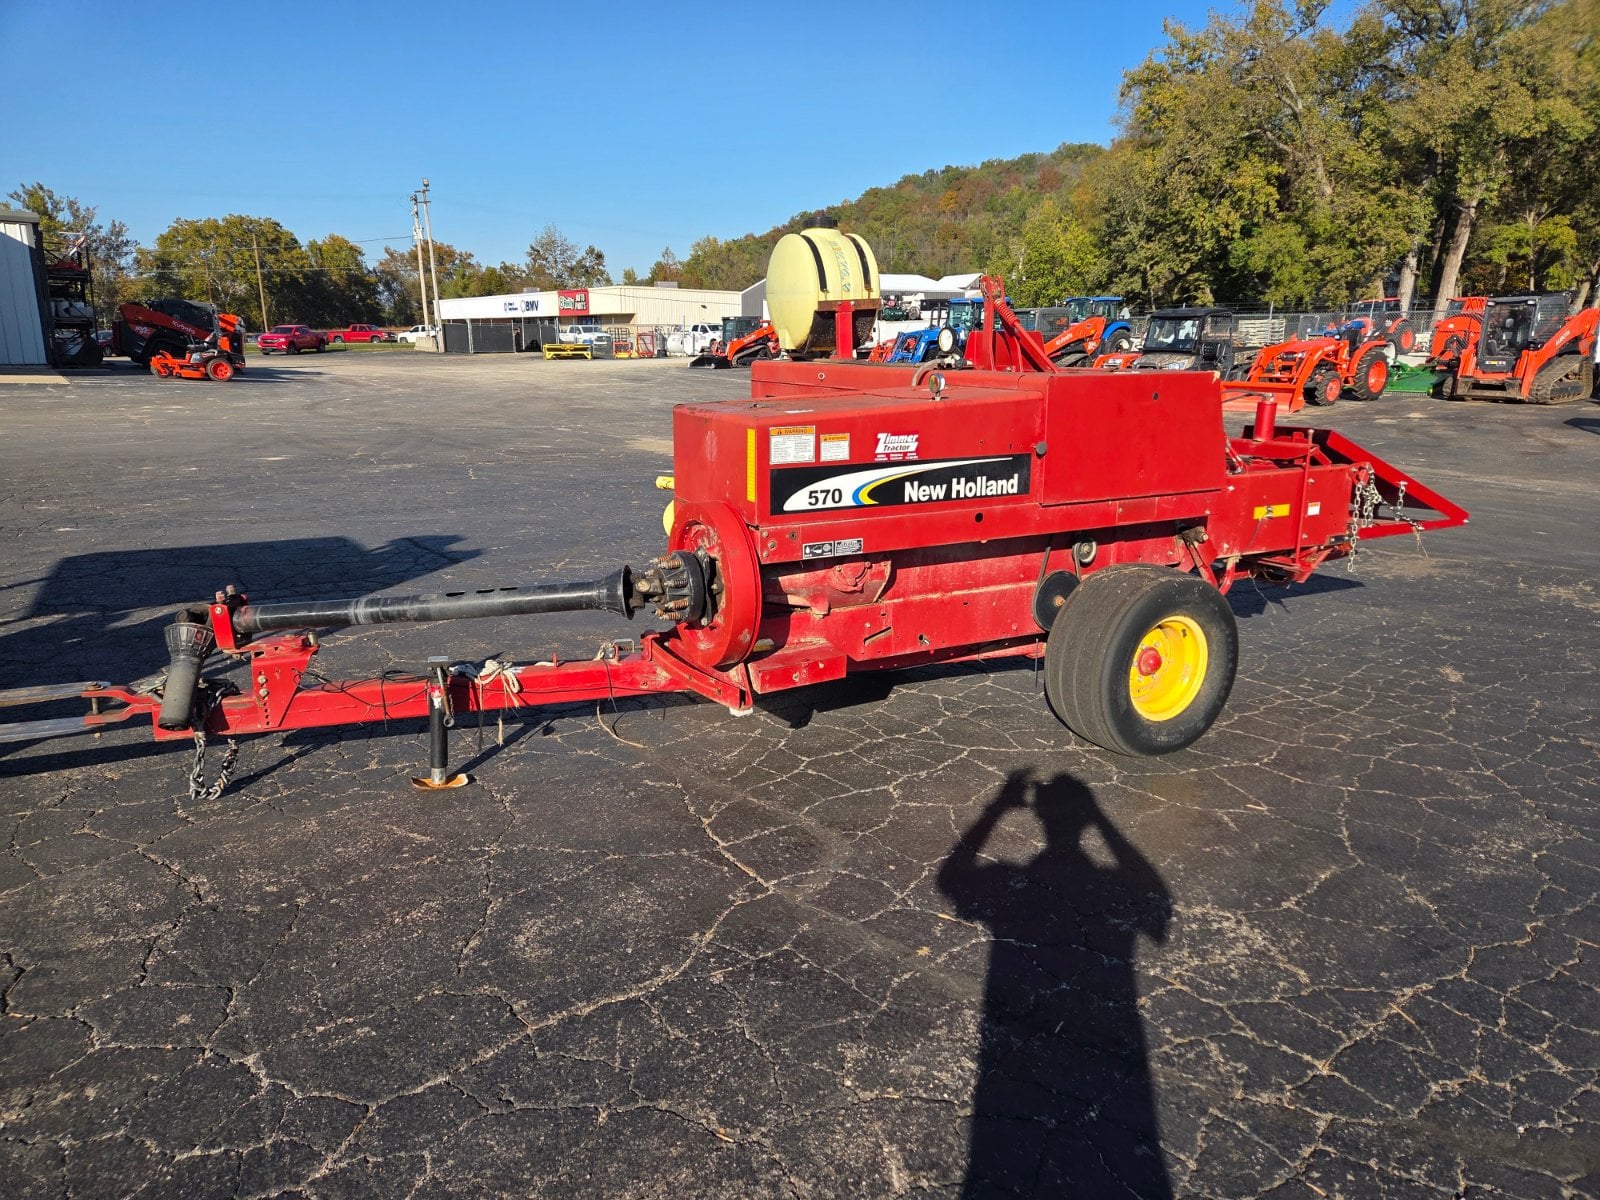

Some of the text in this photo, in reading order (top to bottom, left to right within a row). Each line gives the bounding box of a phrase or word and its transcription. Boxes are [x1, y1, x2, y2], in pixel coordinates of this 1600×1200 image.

[172, 320, 196, 335] Kubota
[875, 432, 919, 451] Zimmer
[883, 444, 911, 452] Tractor
[807, 488, 843, 506] 570
[904, 474, 1019, 502] New Holland
